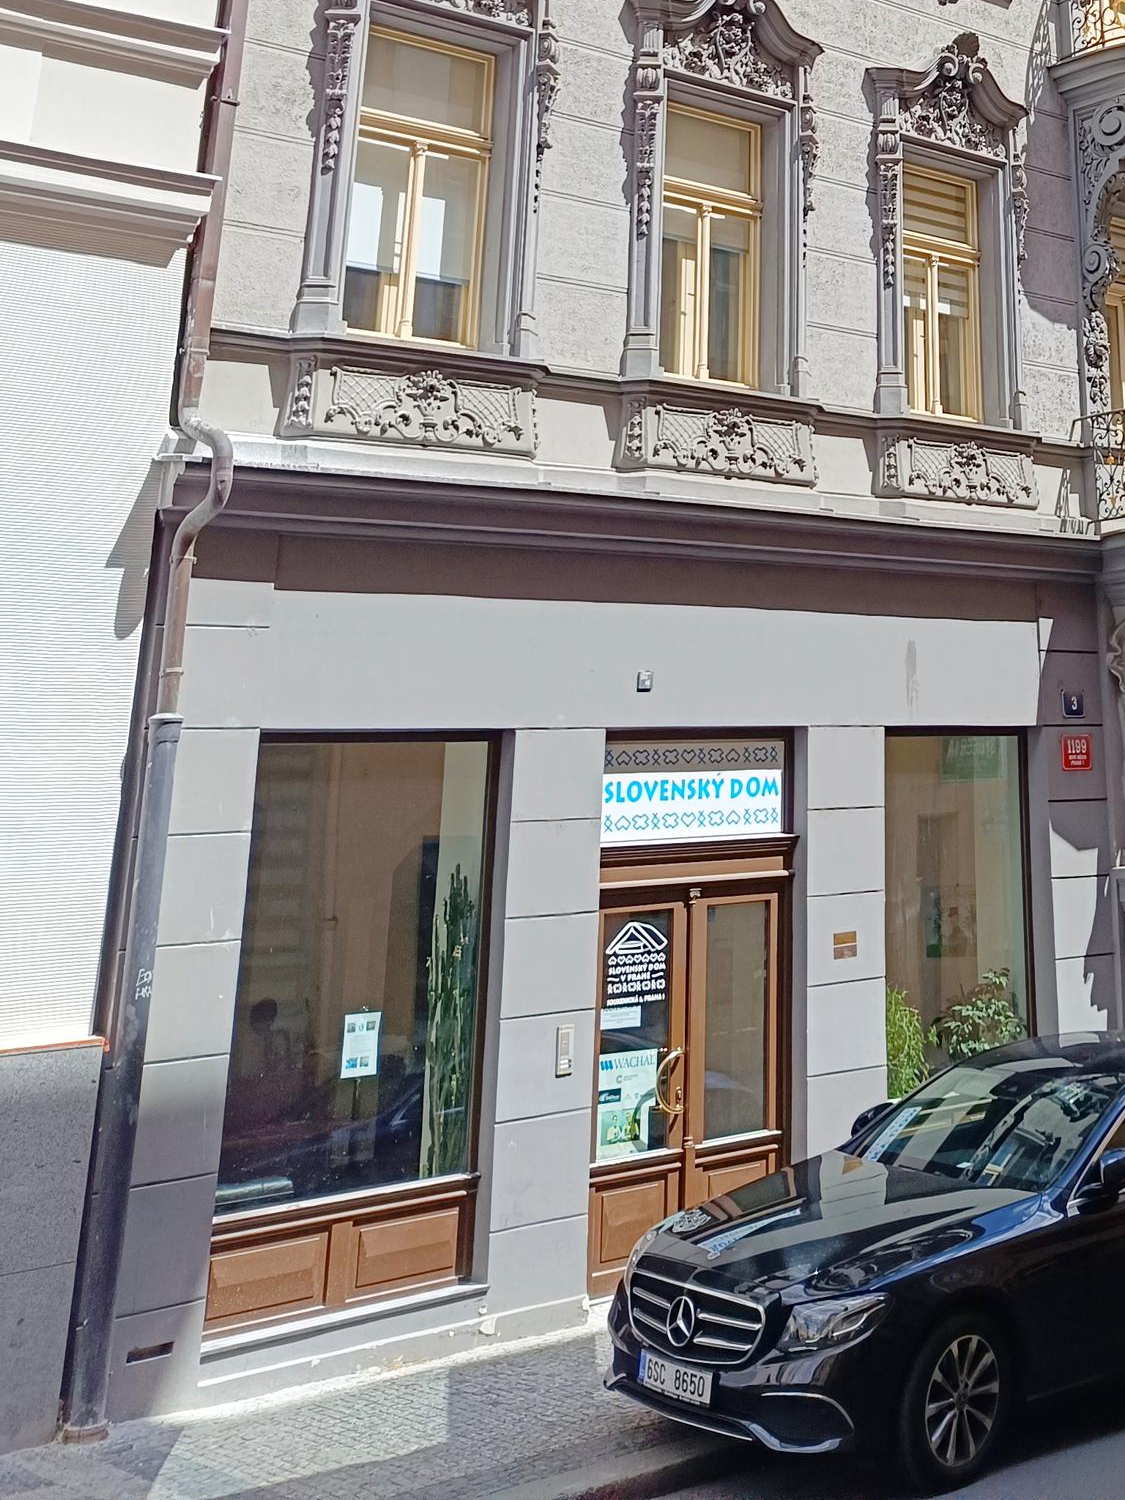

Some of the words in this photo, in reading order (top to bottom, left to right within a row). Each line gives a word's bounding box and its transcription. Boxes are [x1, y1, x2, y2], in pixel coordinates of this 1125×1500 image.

[1071, 696, 1078, 710] 3
[1067, 739, 1087, 754] 1199
[604, 773, 725, 803] SLOVENSKÝ
[730, 776, 780, 799] DOM
[648, 962, 666, 971] DOM
[614, 1054, 656, 1069] WACHAL
[647, 1358, 666, 1385] 6SC
[674, 1369, 705, 1397] 8650
